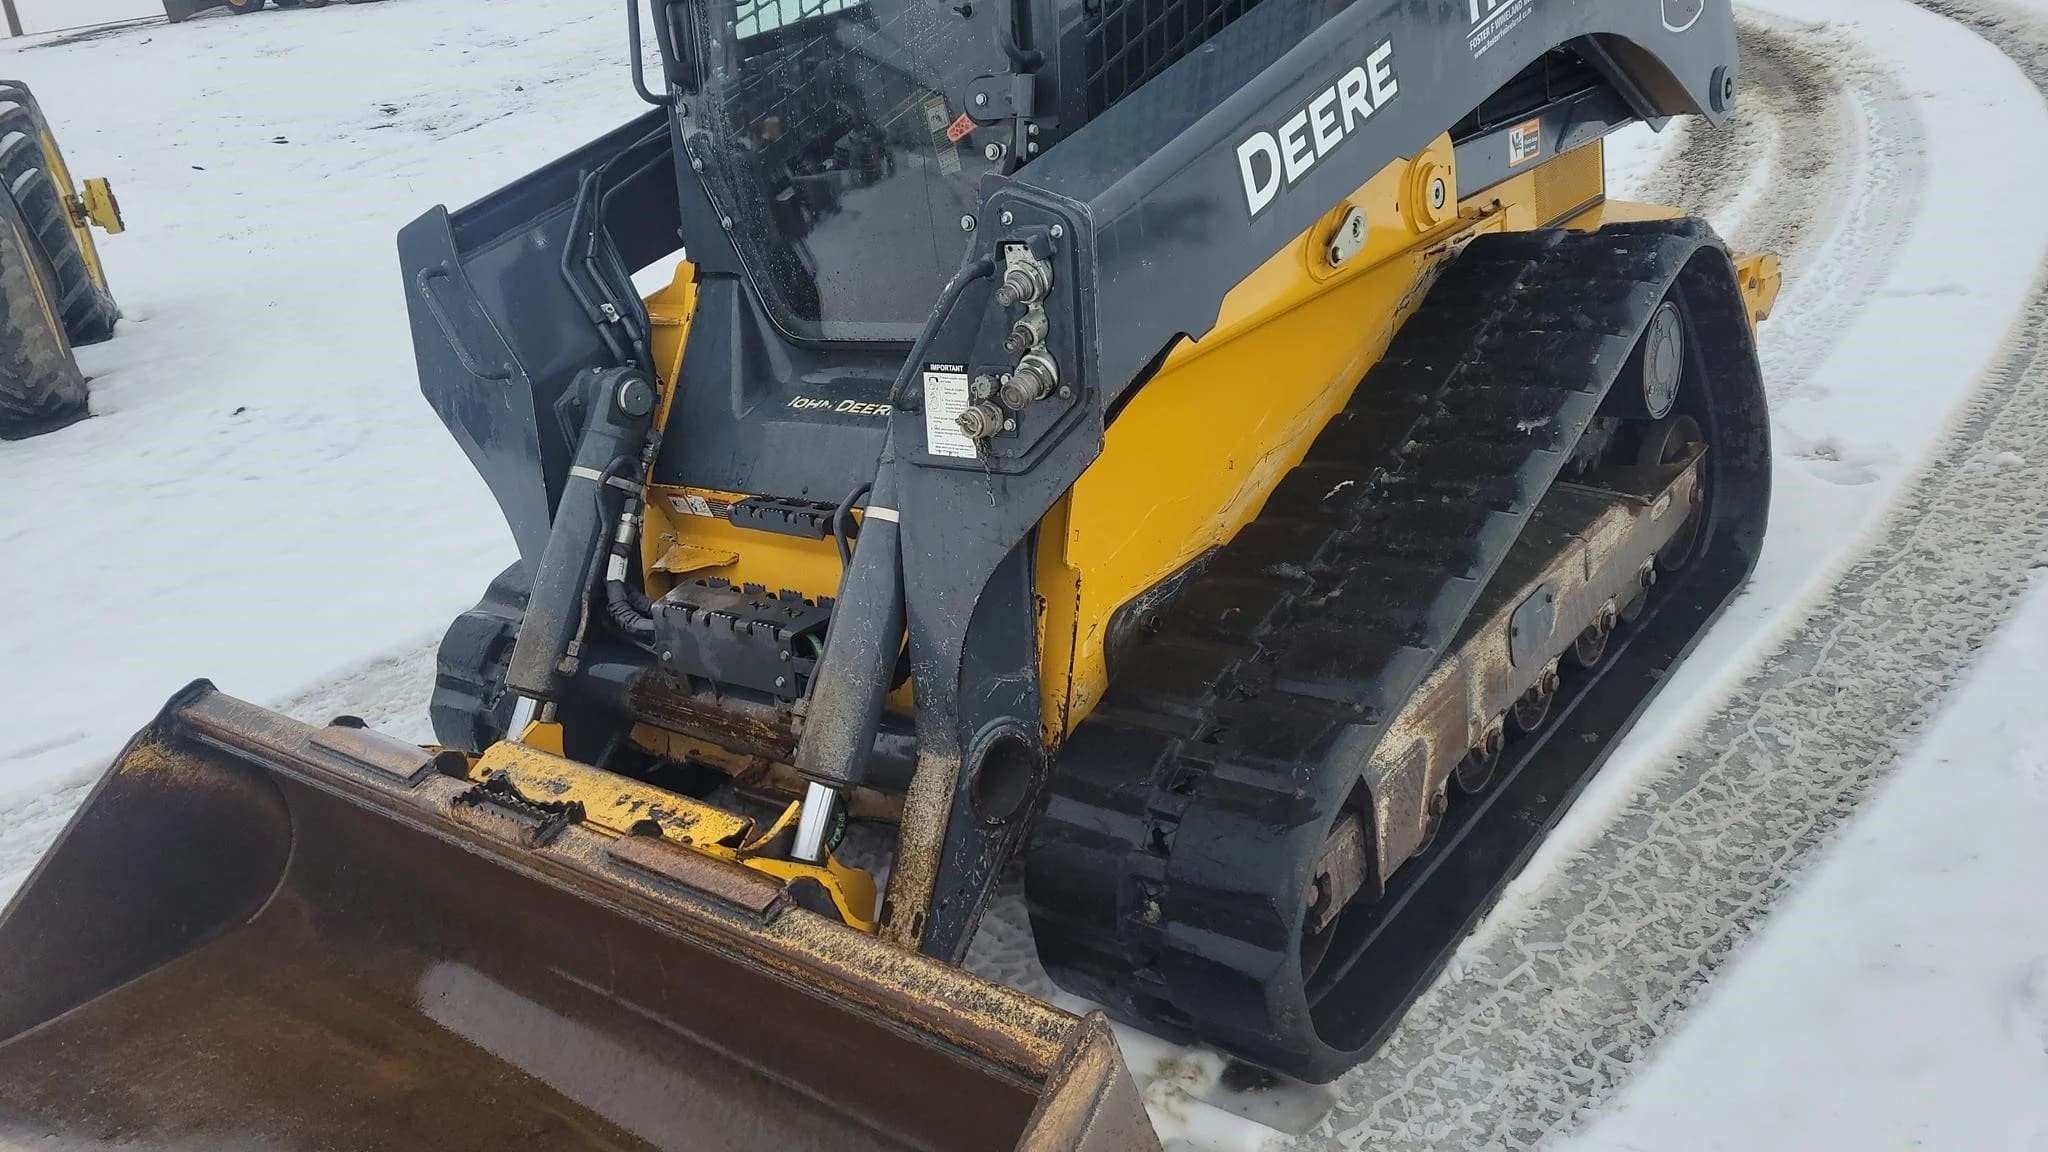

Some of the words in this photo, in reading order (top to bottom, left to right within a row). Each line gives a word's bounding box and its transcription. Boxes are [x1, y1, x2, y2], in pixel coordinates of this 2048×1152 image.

[1469, 26, 1491, 51] FOSTER
[1490, 22, 1495, 33] F
[1236, 40, 1398, 217] DEERE
[930, 363, 964, 372] IMPORTANT
[787, 395, 836, 409] JOHN
[834, 399, 891, 416] DEER
